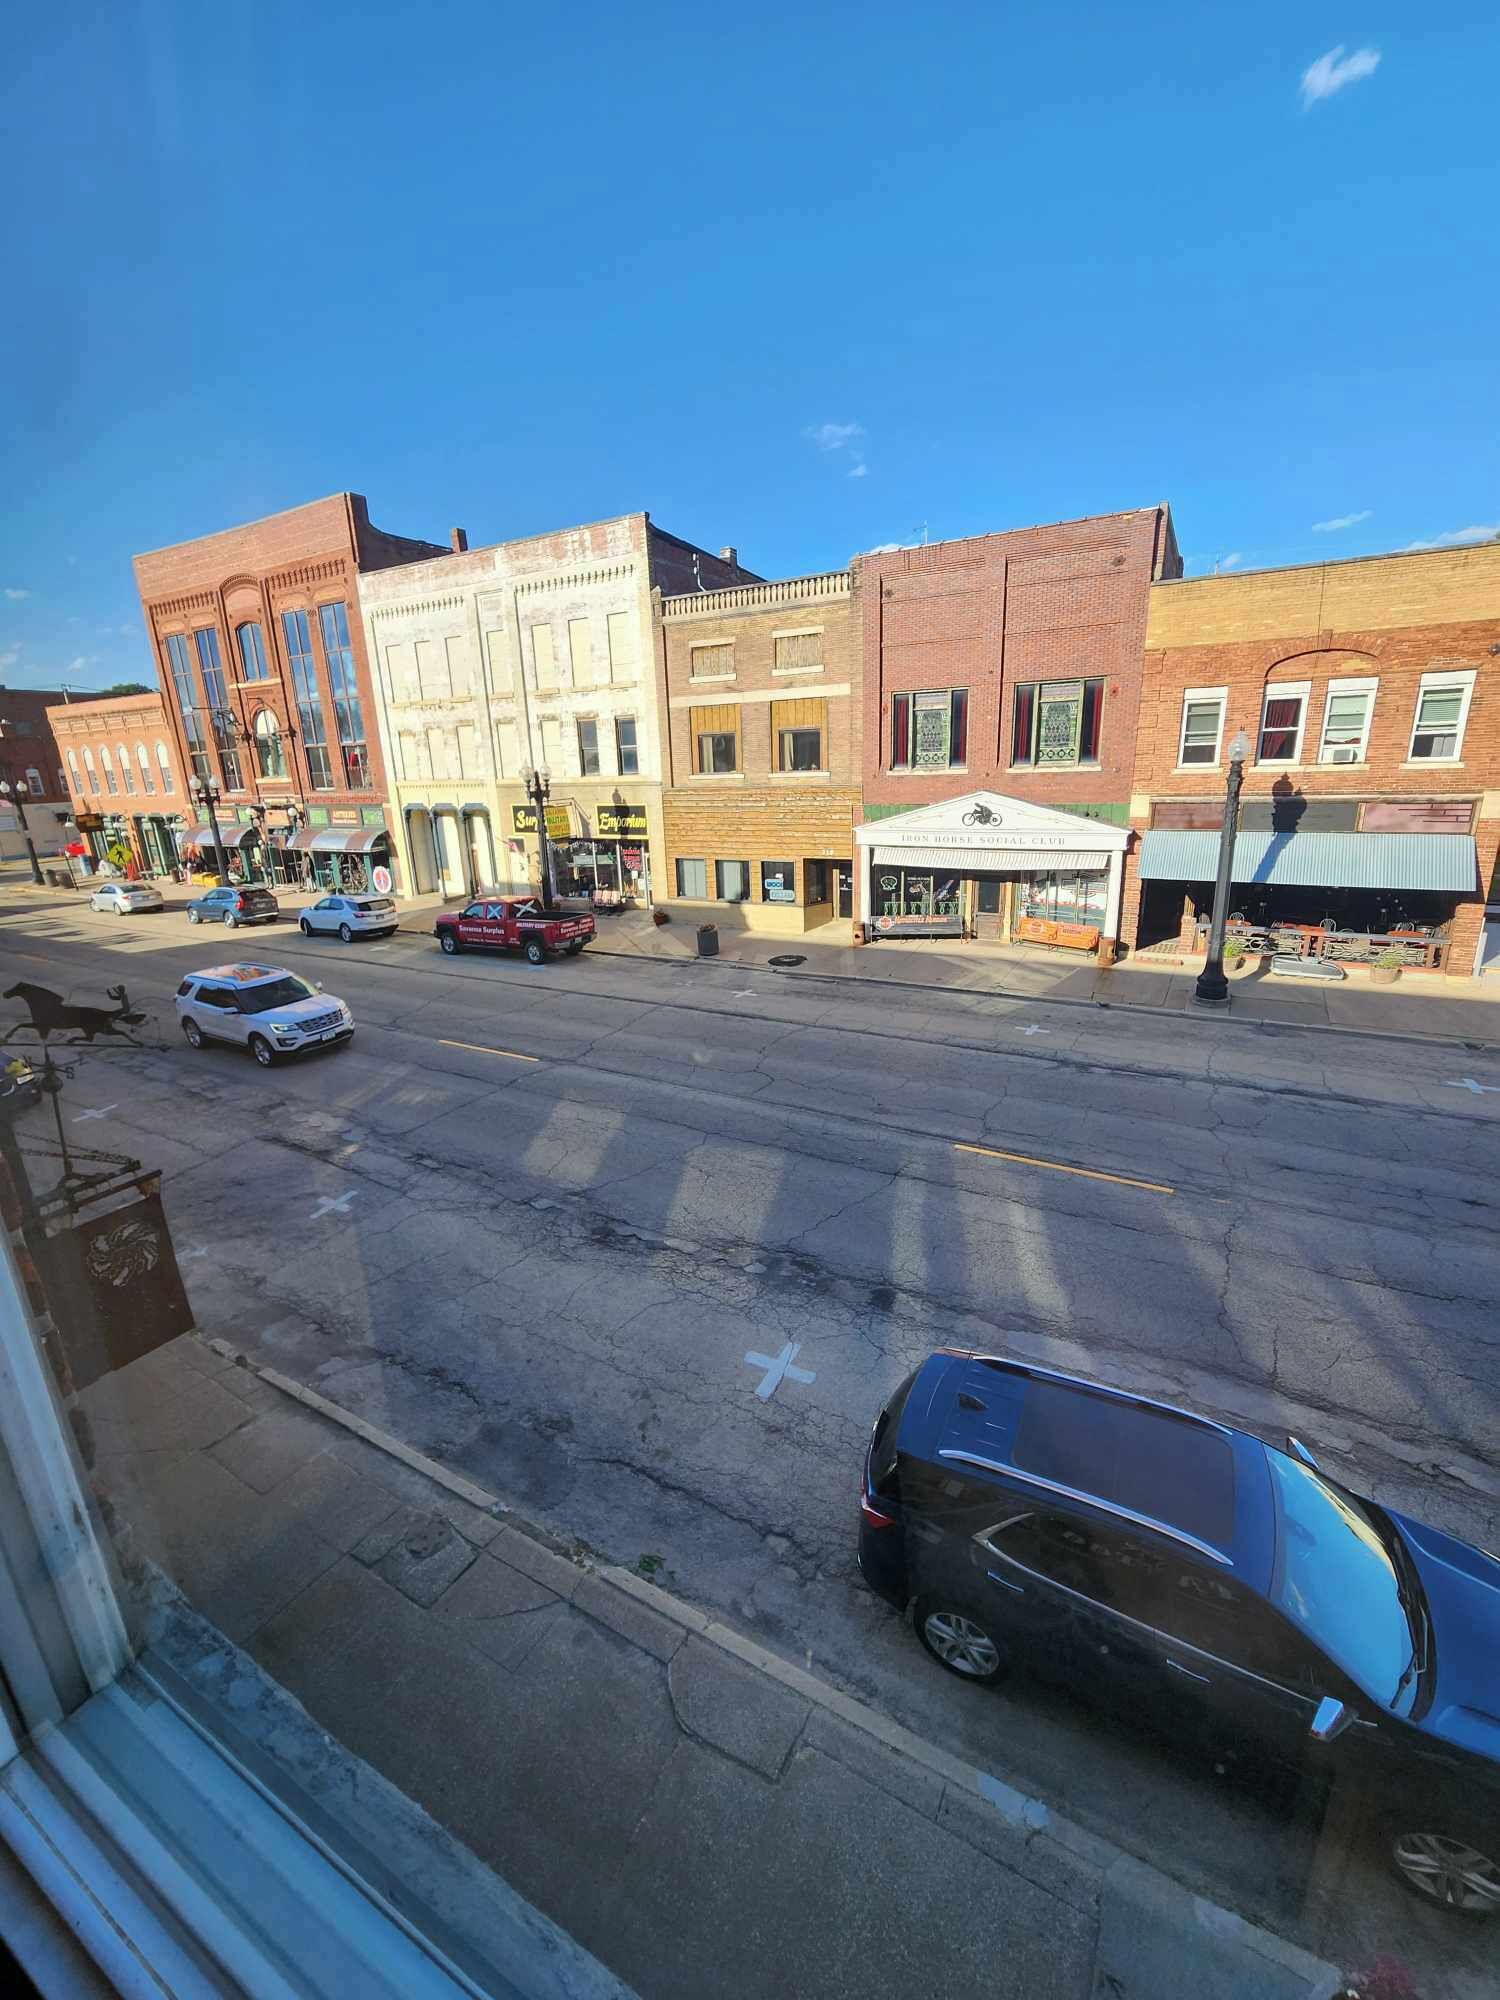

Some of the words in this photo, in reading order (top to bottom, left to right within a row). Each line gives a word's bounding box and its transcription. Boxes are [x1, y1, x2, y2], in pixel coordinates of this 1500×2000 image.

[599, 812, 647, 831] Emporium
[901, 834, 929, 842] IRON
[934, 835, 972, 843] HORSE
[979, 836, 1027, 845] SOCIAL
[1031, 836, 1065, 845] CLUB
[483, 925, 505, 935] Surplus
